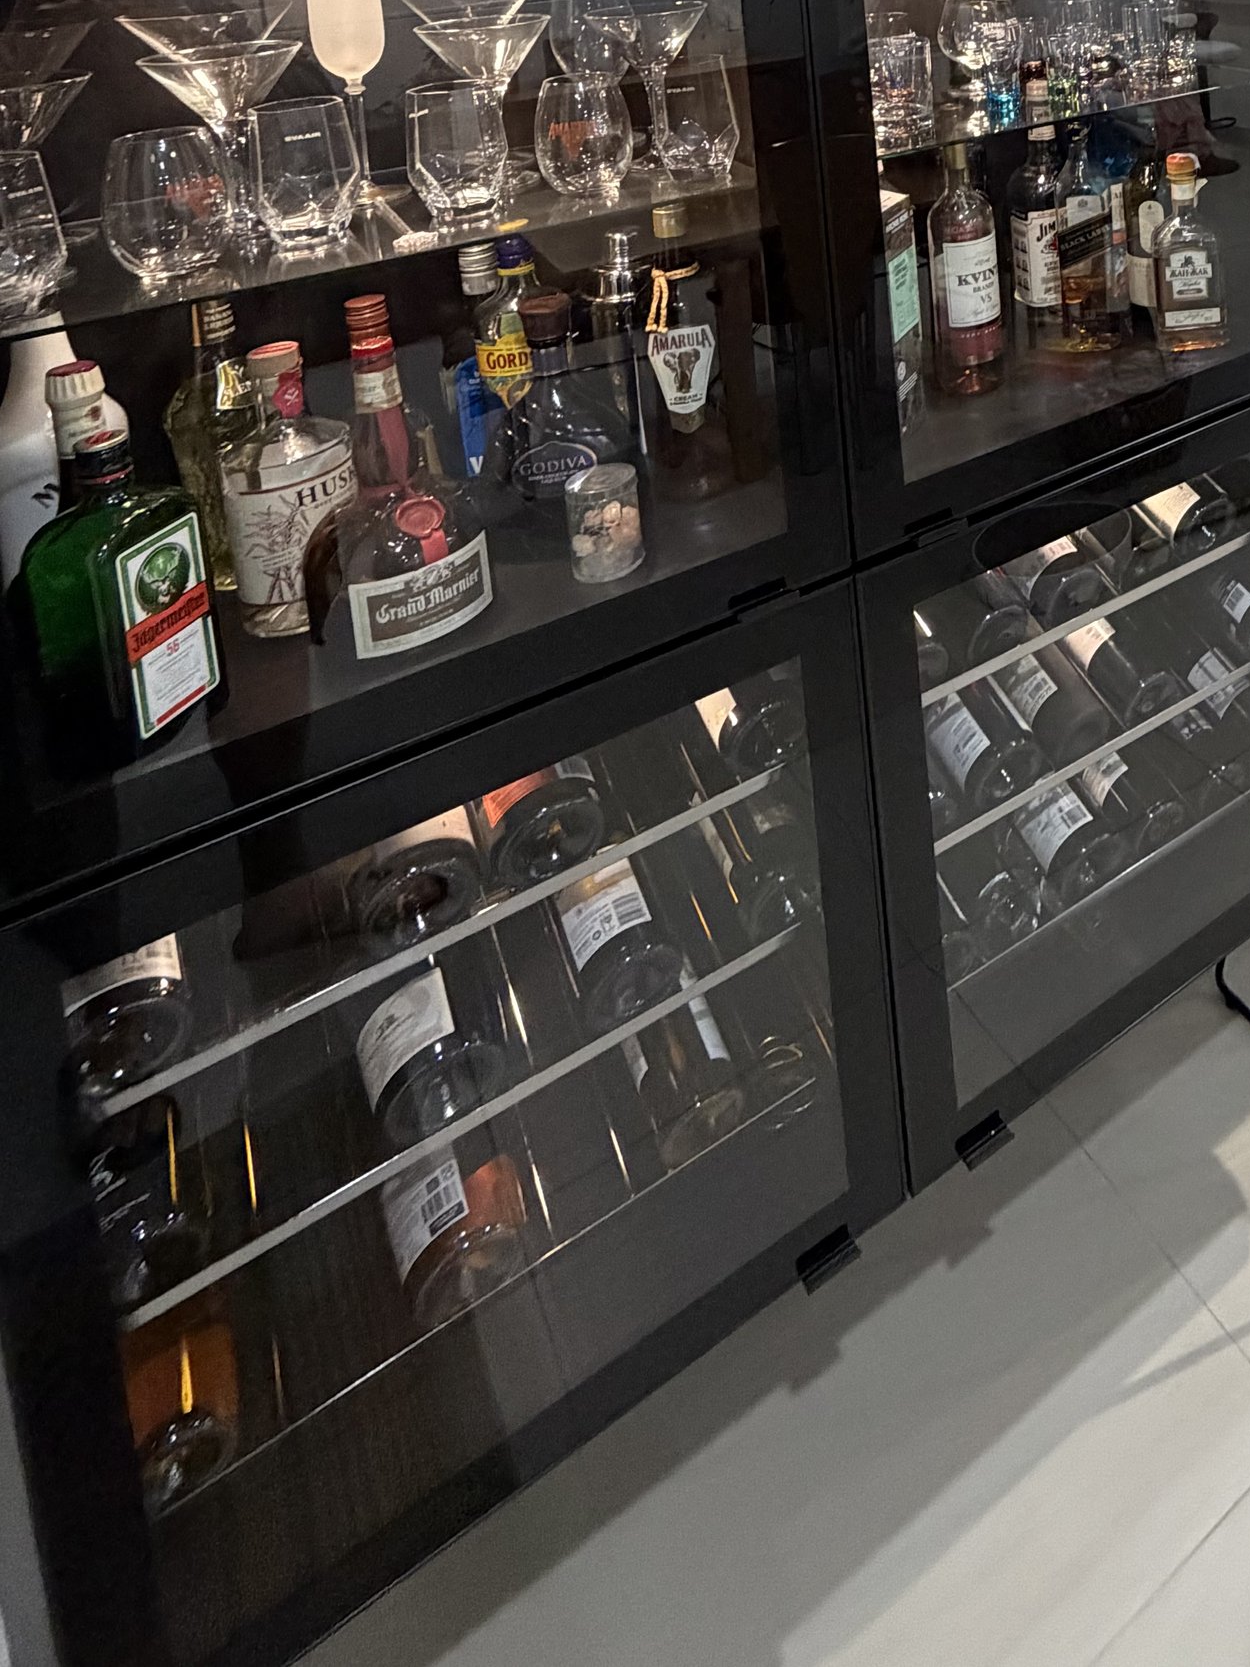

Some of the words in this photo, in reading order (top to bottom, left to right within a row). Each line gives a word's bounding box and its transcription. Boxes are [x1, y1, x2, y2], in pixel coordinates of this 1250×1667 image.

[1036, 220, 1056, 242] JIM
[651, 327, 713, 357] AMARULA
[486, 350, 529, 370] GORD
[519, 455, 588, 475] GODIVA
[375, 594, 426, 624] Grand
[425, 566, 480, 609] Marnier
